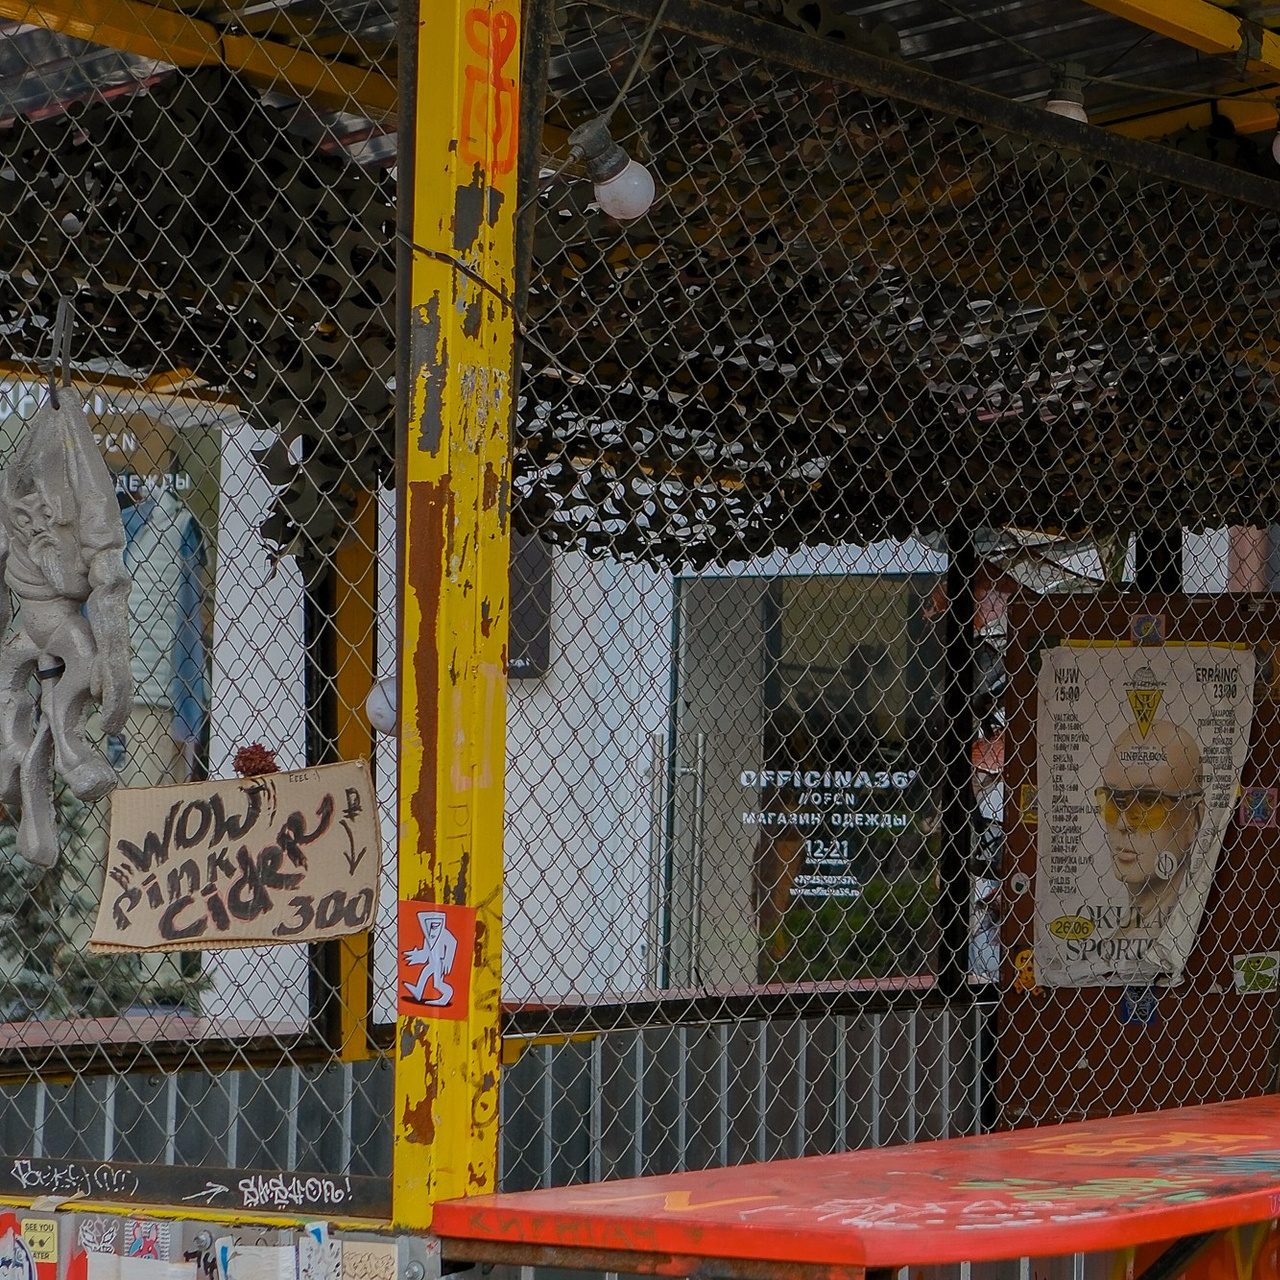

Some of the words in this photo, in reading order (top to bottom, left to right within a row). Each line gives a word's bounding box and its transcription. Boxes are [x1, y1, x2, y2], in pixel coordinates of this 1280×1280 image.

[742, 813, 822, 827] МАГАЗИН
[831, 813, 907, 828] ОДЕЖДЫ
[805, 839, 850, 858] 12-21
[272, 886, 375, 937] 300
[24, 1223, 39, 1232] SEE
[40, 1223, 55, 1232] YOU
[31, 1252, 50, 1260] ATER
